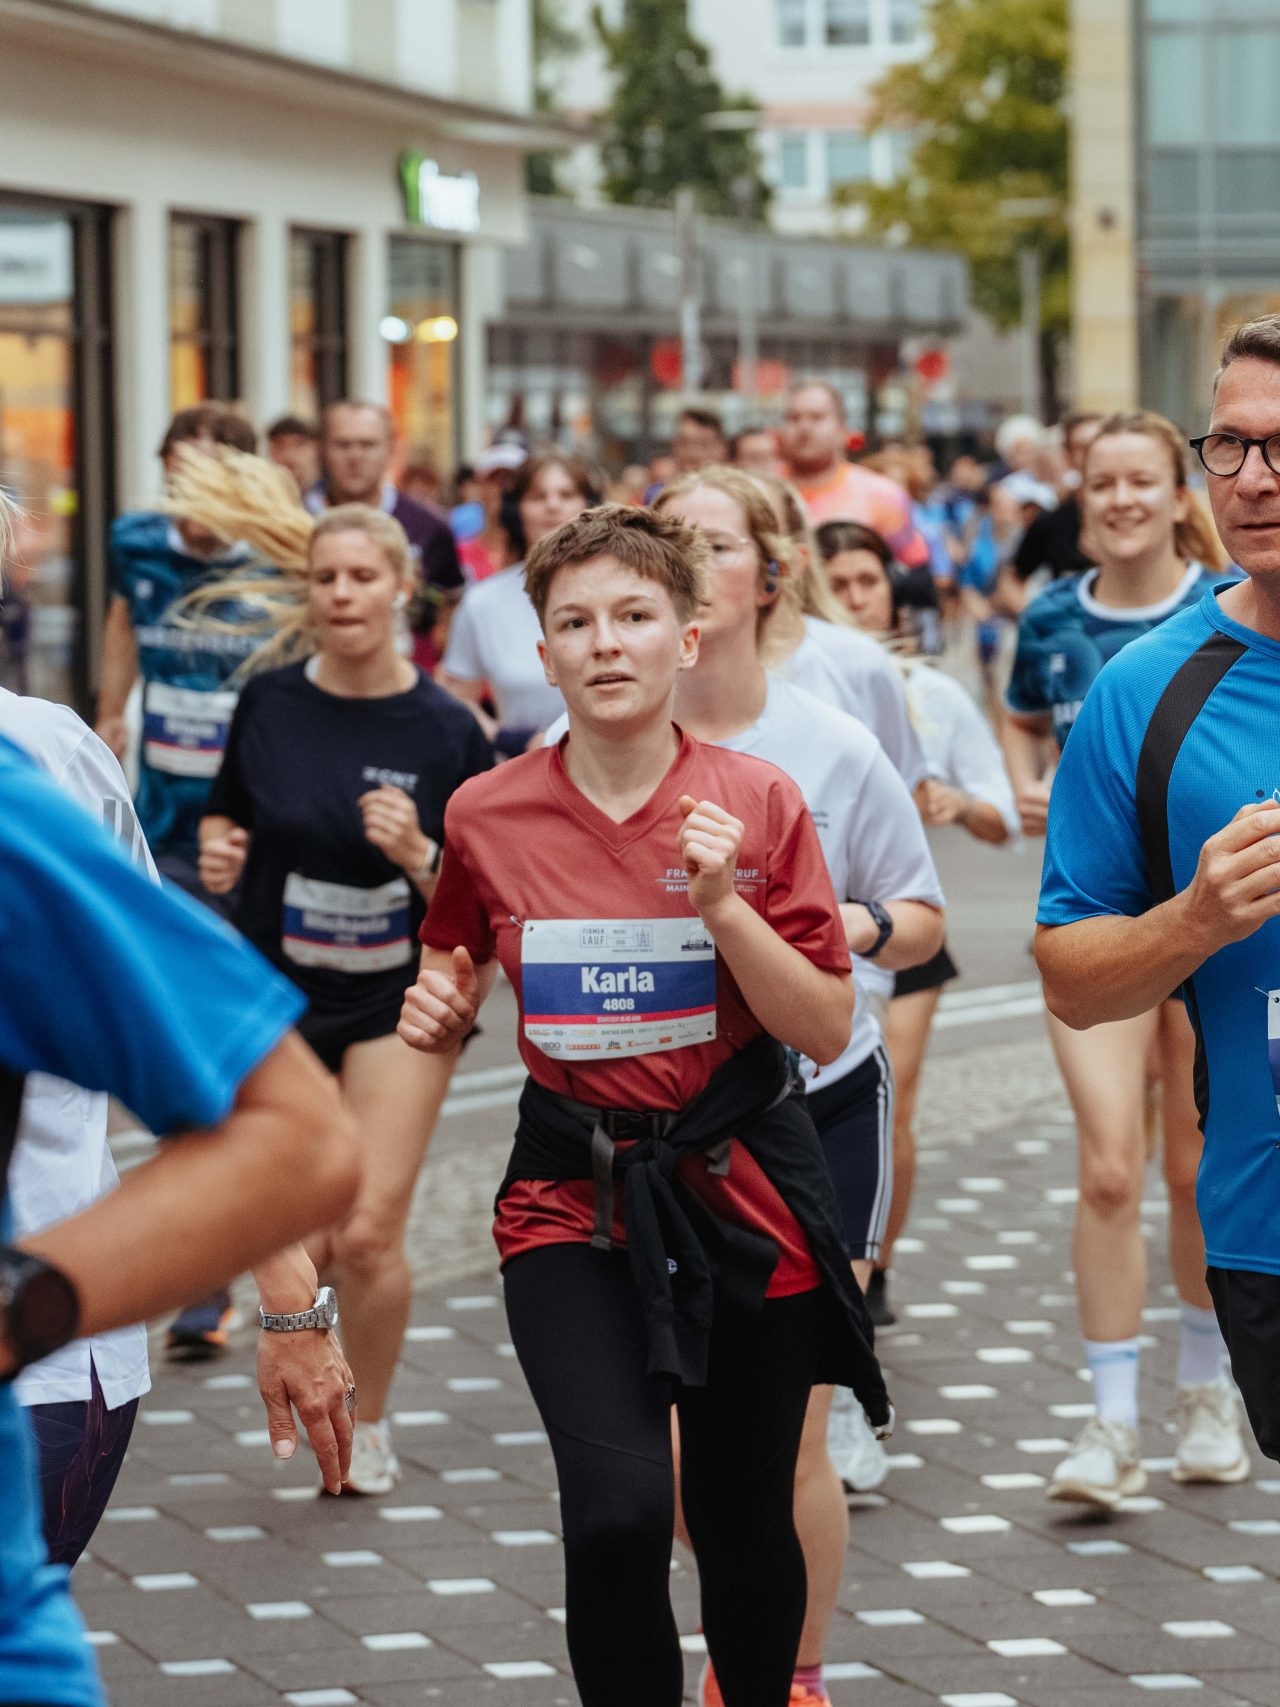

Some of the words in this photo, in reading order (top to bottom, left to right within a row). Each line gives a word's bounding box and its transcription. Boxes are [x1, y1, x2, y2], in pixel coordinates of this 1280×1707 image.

[582, 935, 605, 945] LAUF
[580, 966, 655, 994] Karla
[602, 998, 635, 1011] 4808
